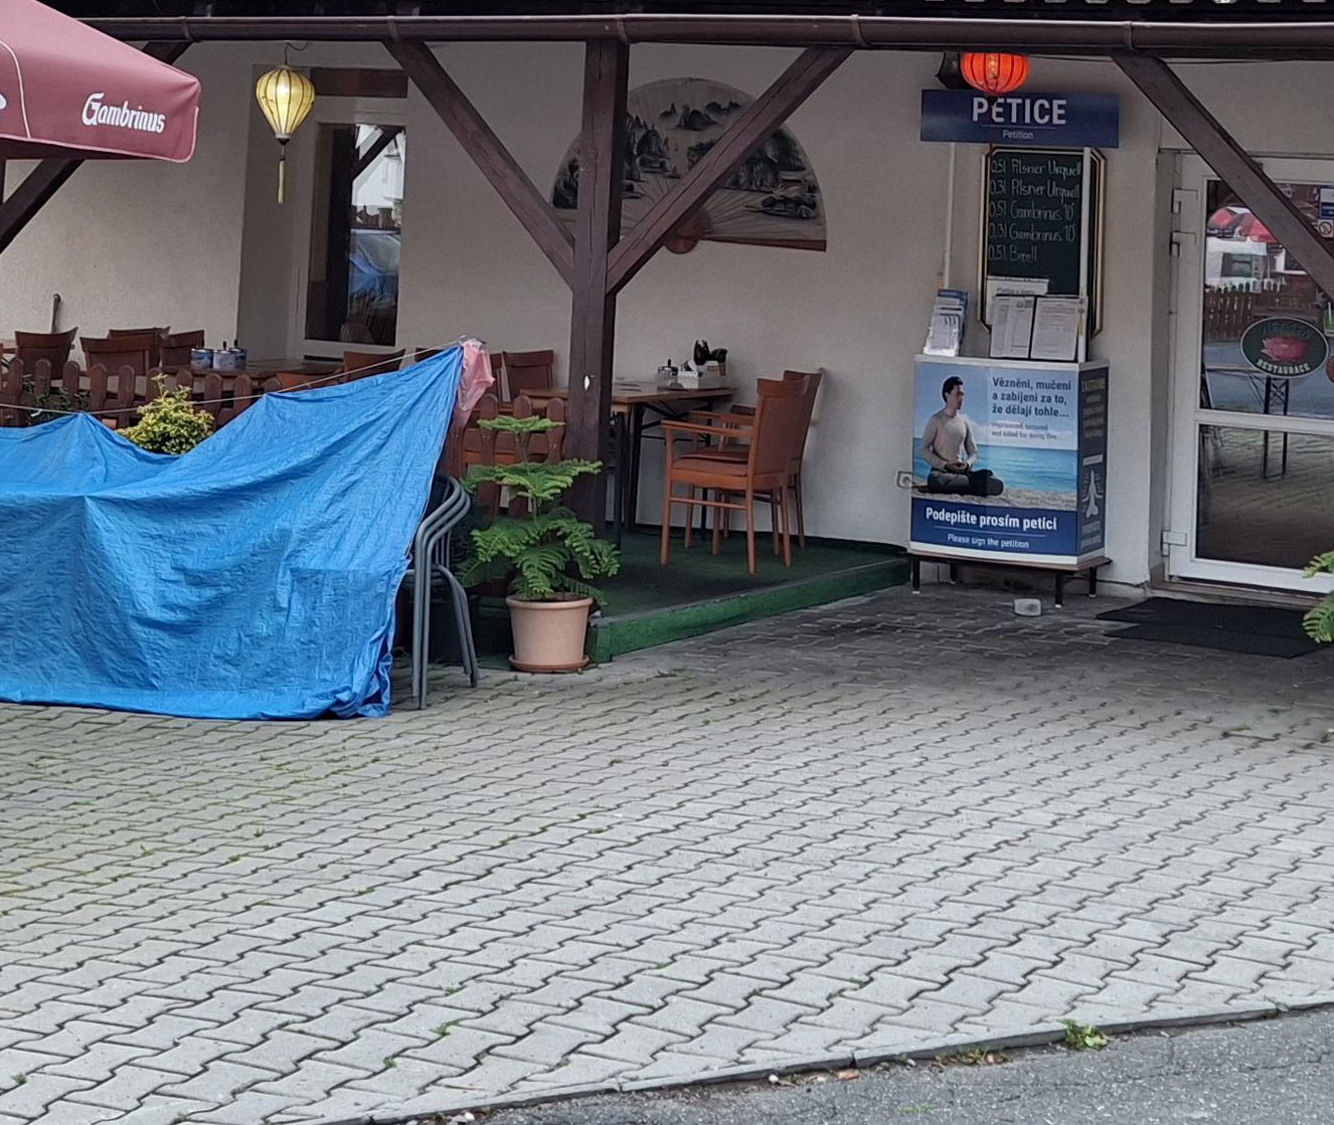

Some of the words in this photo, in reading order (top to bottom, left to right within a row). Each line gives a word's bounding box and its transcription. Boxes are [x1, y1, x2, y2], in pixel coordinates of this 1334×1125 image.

[82, 92, 166, 133] Gambrinus
[972, 97, 1067, 125] PETICE
[1002, 129, 1034, 140] Petition
[1011, 158, 1045, 175] Pilsner
[1011, 178, 1045, 195] Pilsner
[1010, 200, 1062, 220] Gambrinus
[1009, 222, 1062, 242] Gambrinus
[1256, 358, 1311, 375] RESTAURACE
[992, 404, 1003, 414] že
[1040, 395, 1052, 403] za
[1054, 395, 1067, 406] to,
[926, 507, 977, 525] Podepište
[979, 514, 1020, 528] prosím
[1023, 517, 1058, 531] petici
[948, 533, 970, 544] Please
[987, 536, 999, 547] the
[1001, 539, 1029, 548] petition
